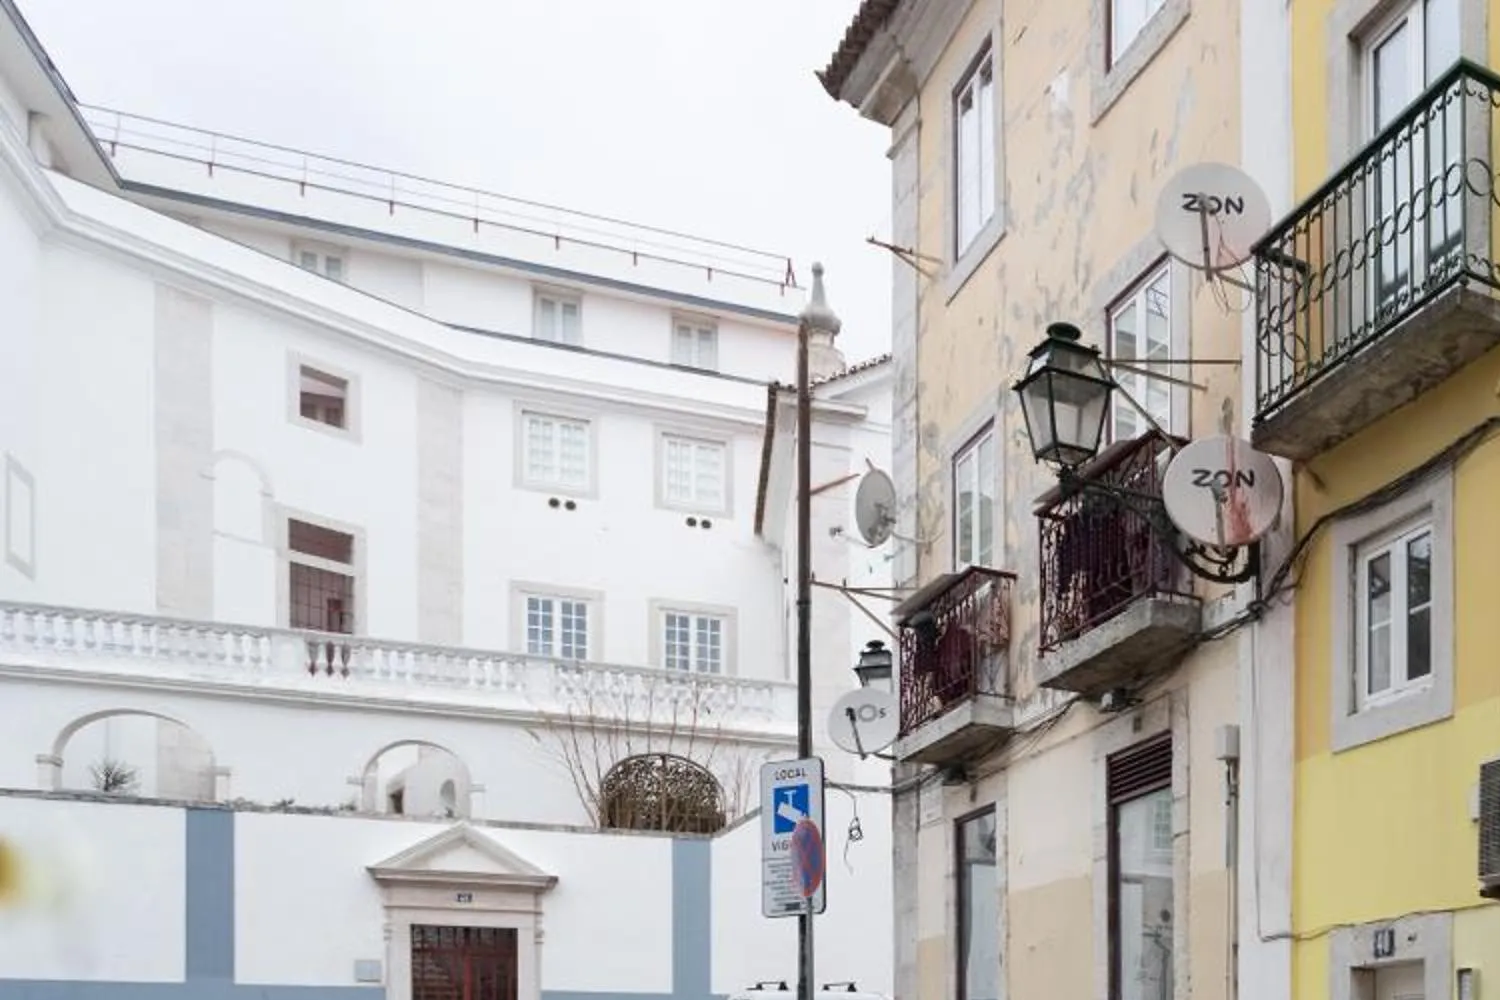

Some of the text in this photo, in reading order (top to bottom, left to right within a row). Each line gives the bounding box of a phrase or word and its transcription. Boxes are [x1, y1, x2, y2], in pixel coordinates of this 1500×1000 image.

[1181, 192, 1244, 215] ZON
[1191, 468, 1255, 489] ZON
[775, 767, 808, 781] LOCAL
